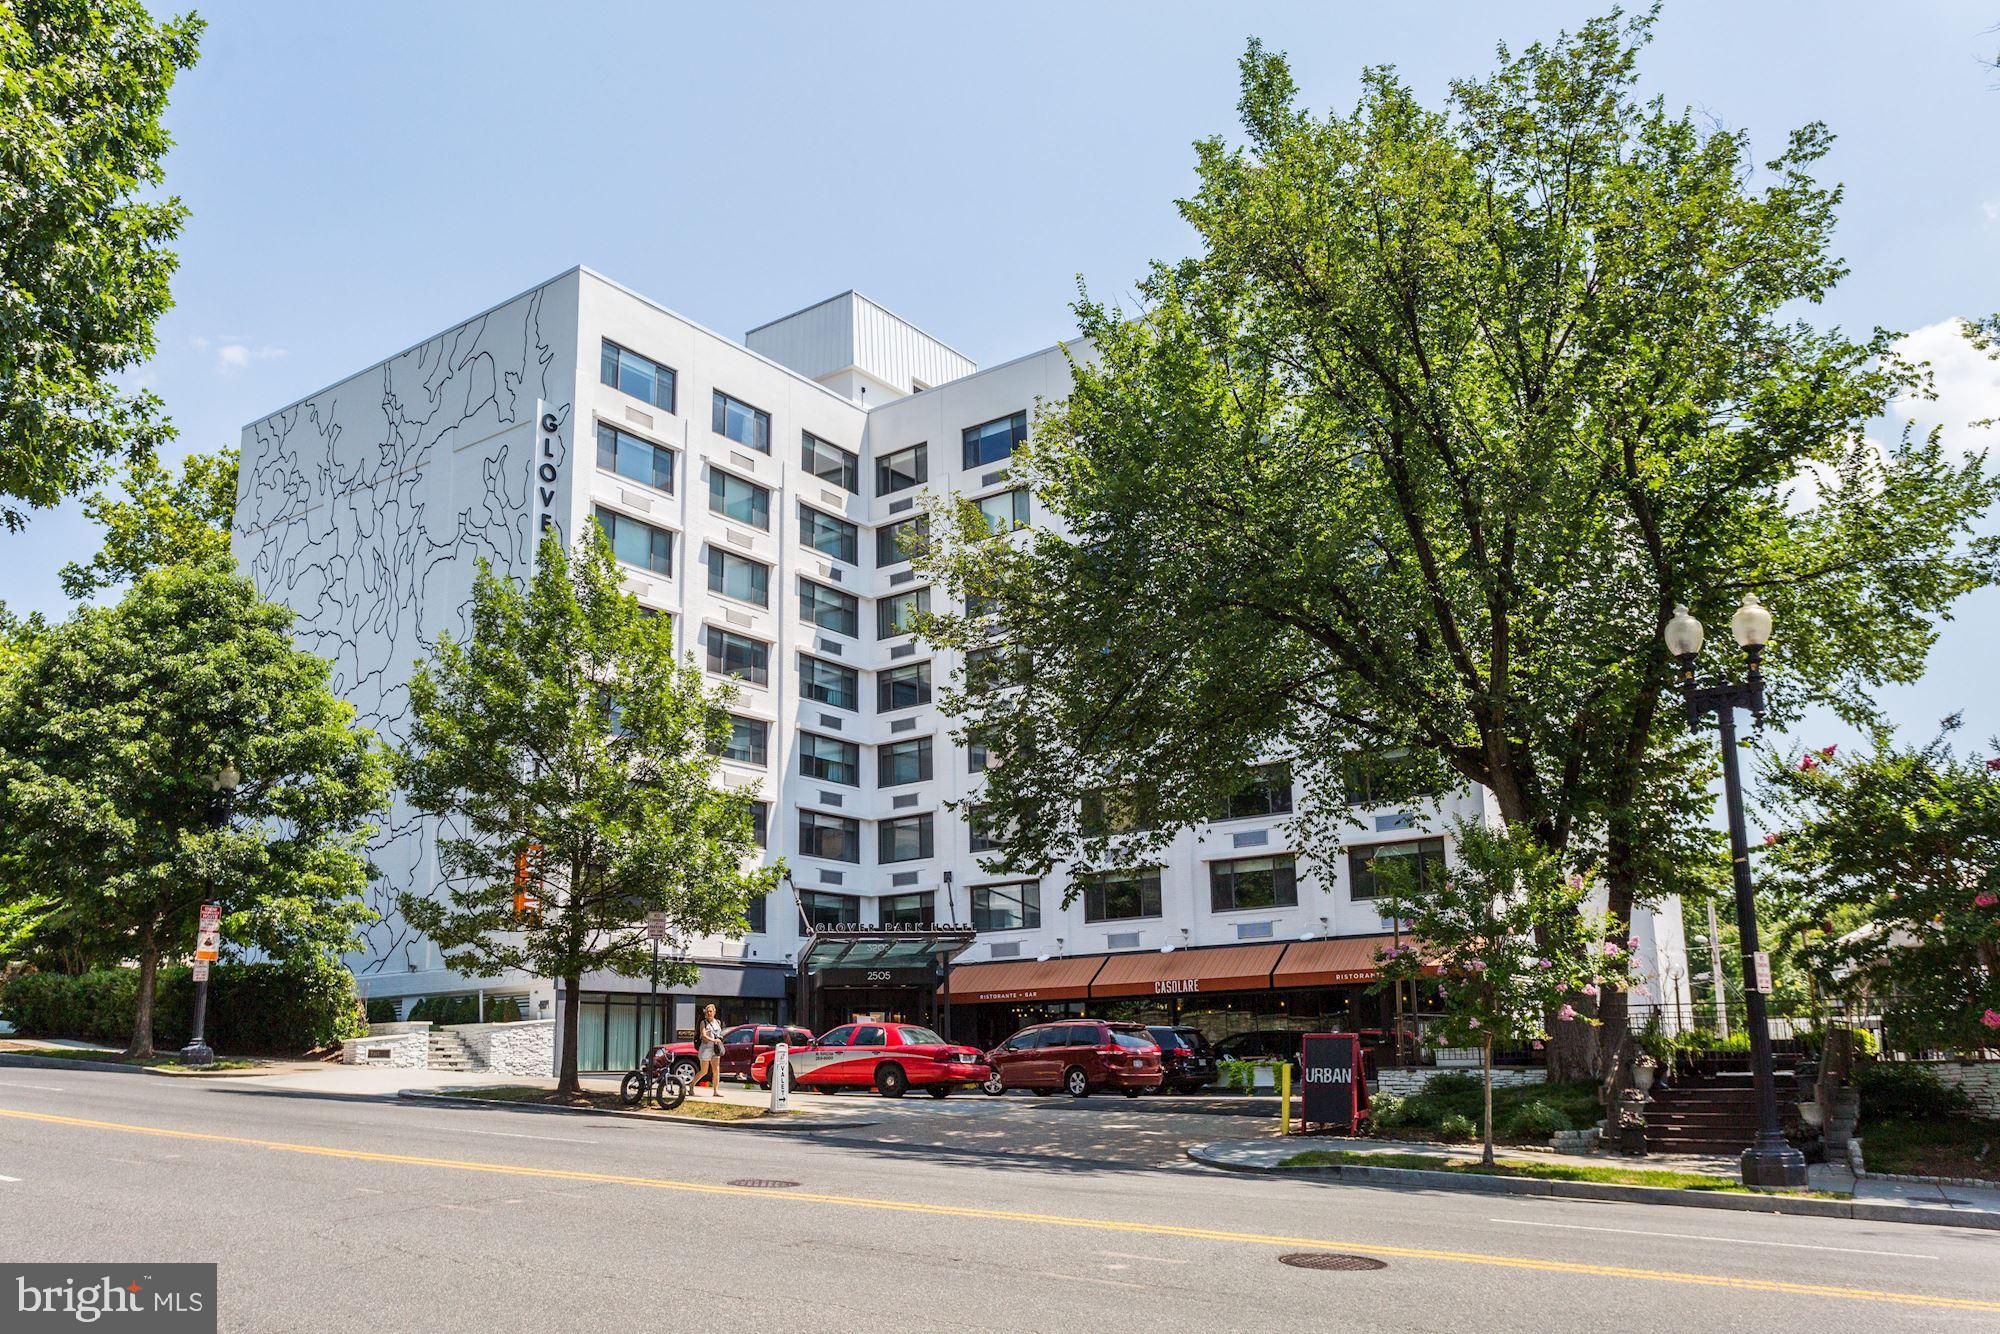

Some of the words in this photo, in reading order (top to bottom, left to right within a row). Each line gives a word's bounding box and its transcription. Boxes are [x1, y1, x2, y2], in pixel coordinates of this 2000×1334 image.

[539, 413, 558, 550] GLOVE
[815, 922, 876, 932] GLOVER
[885, 922, 924, 932] PARK
[931, 922, 977, 932] HOTEL
[867, 971, 891, 980] 2505
[1155, 979, 1200, 994] CASOLARE
[1305, 1067, 1352, 1084] URBAN
